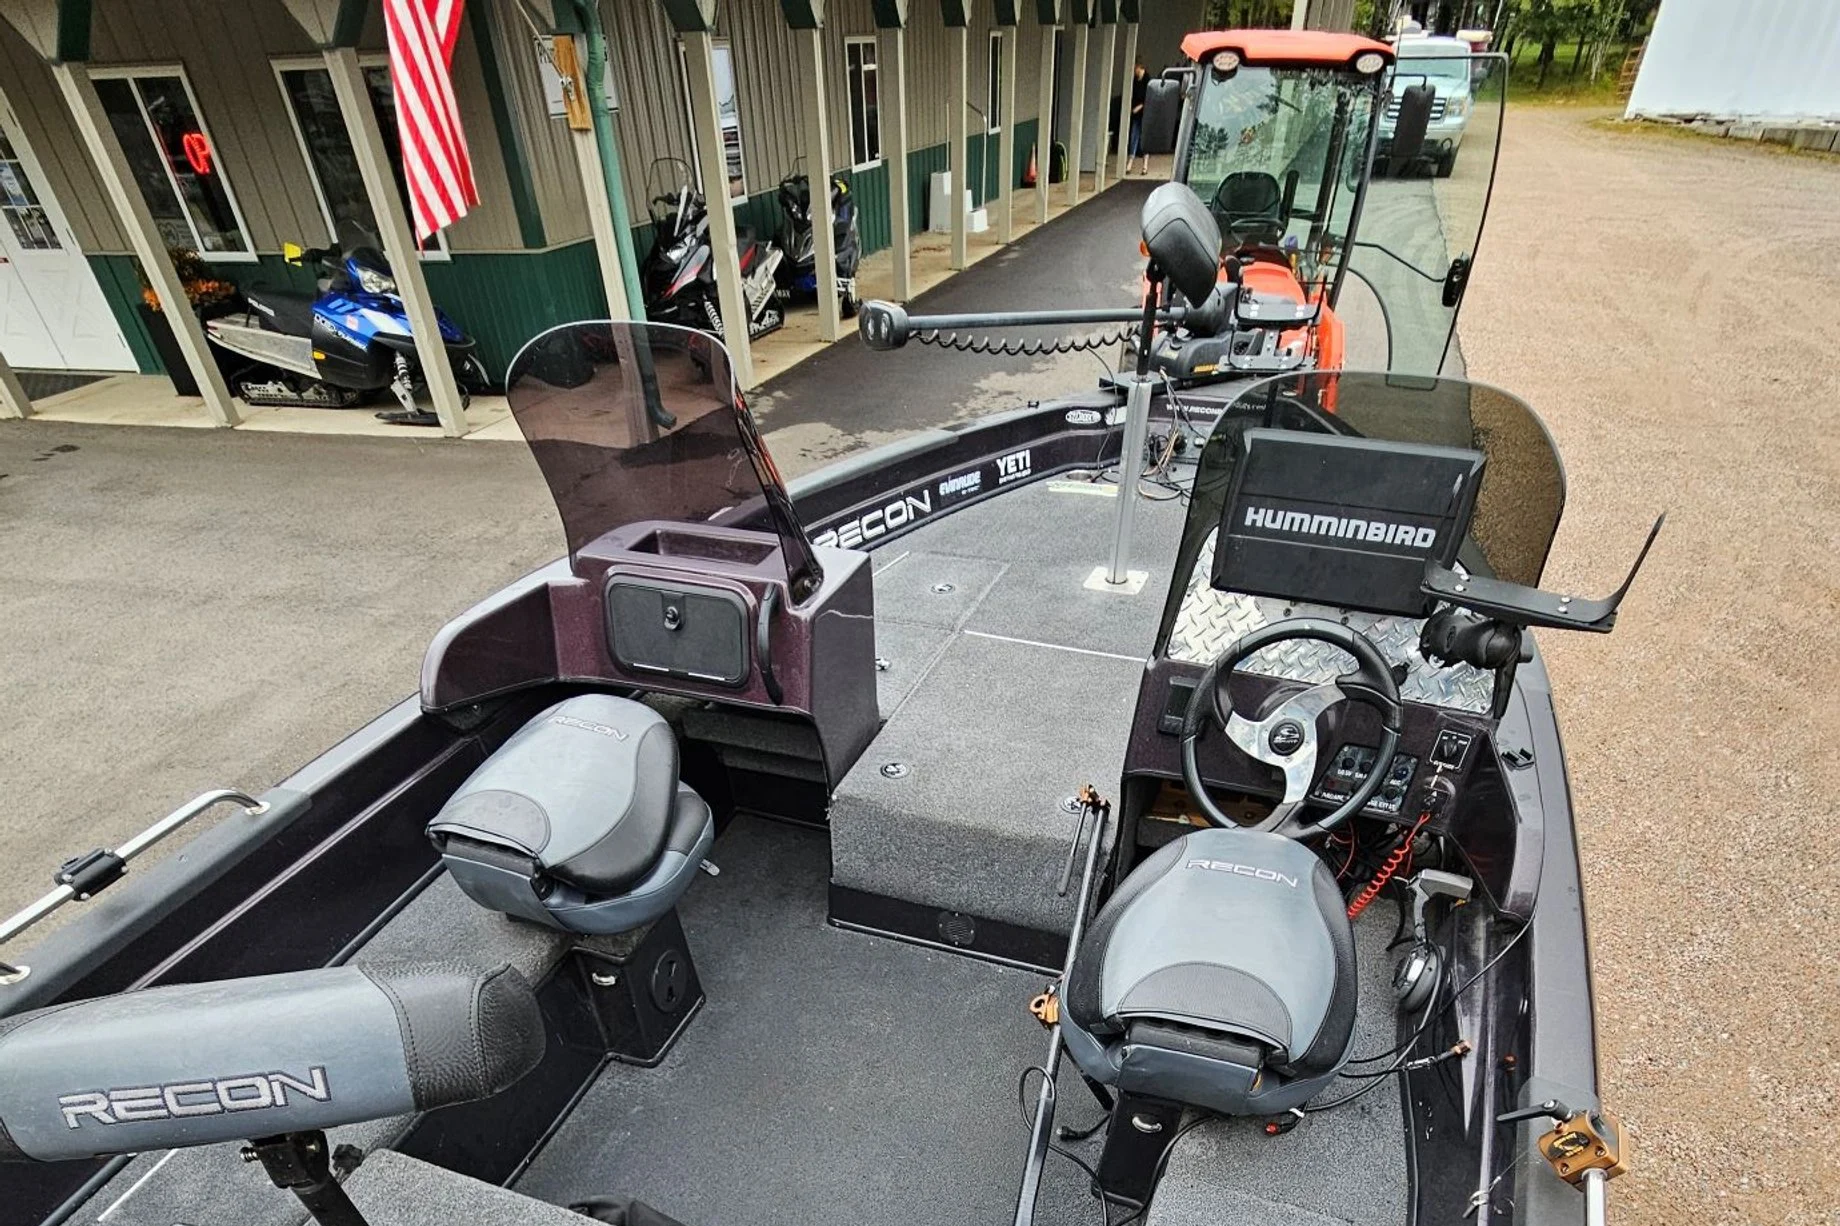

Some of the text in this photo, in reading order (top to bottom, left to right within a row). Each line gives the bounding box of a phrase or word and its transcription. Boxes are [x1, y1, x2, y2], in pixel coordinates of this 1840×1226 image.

[996, 449, 1031, 476] YETI
[1244, 506, 1437, 549] HUMMINBIRD
[548, 716, 629, 742] RECON
[1187, 859, 1299, 888] RECON
[59, 1066, 331, 1129] RECON
